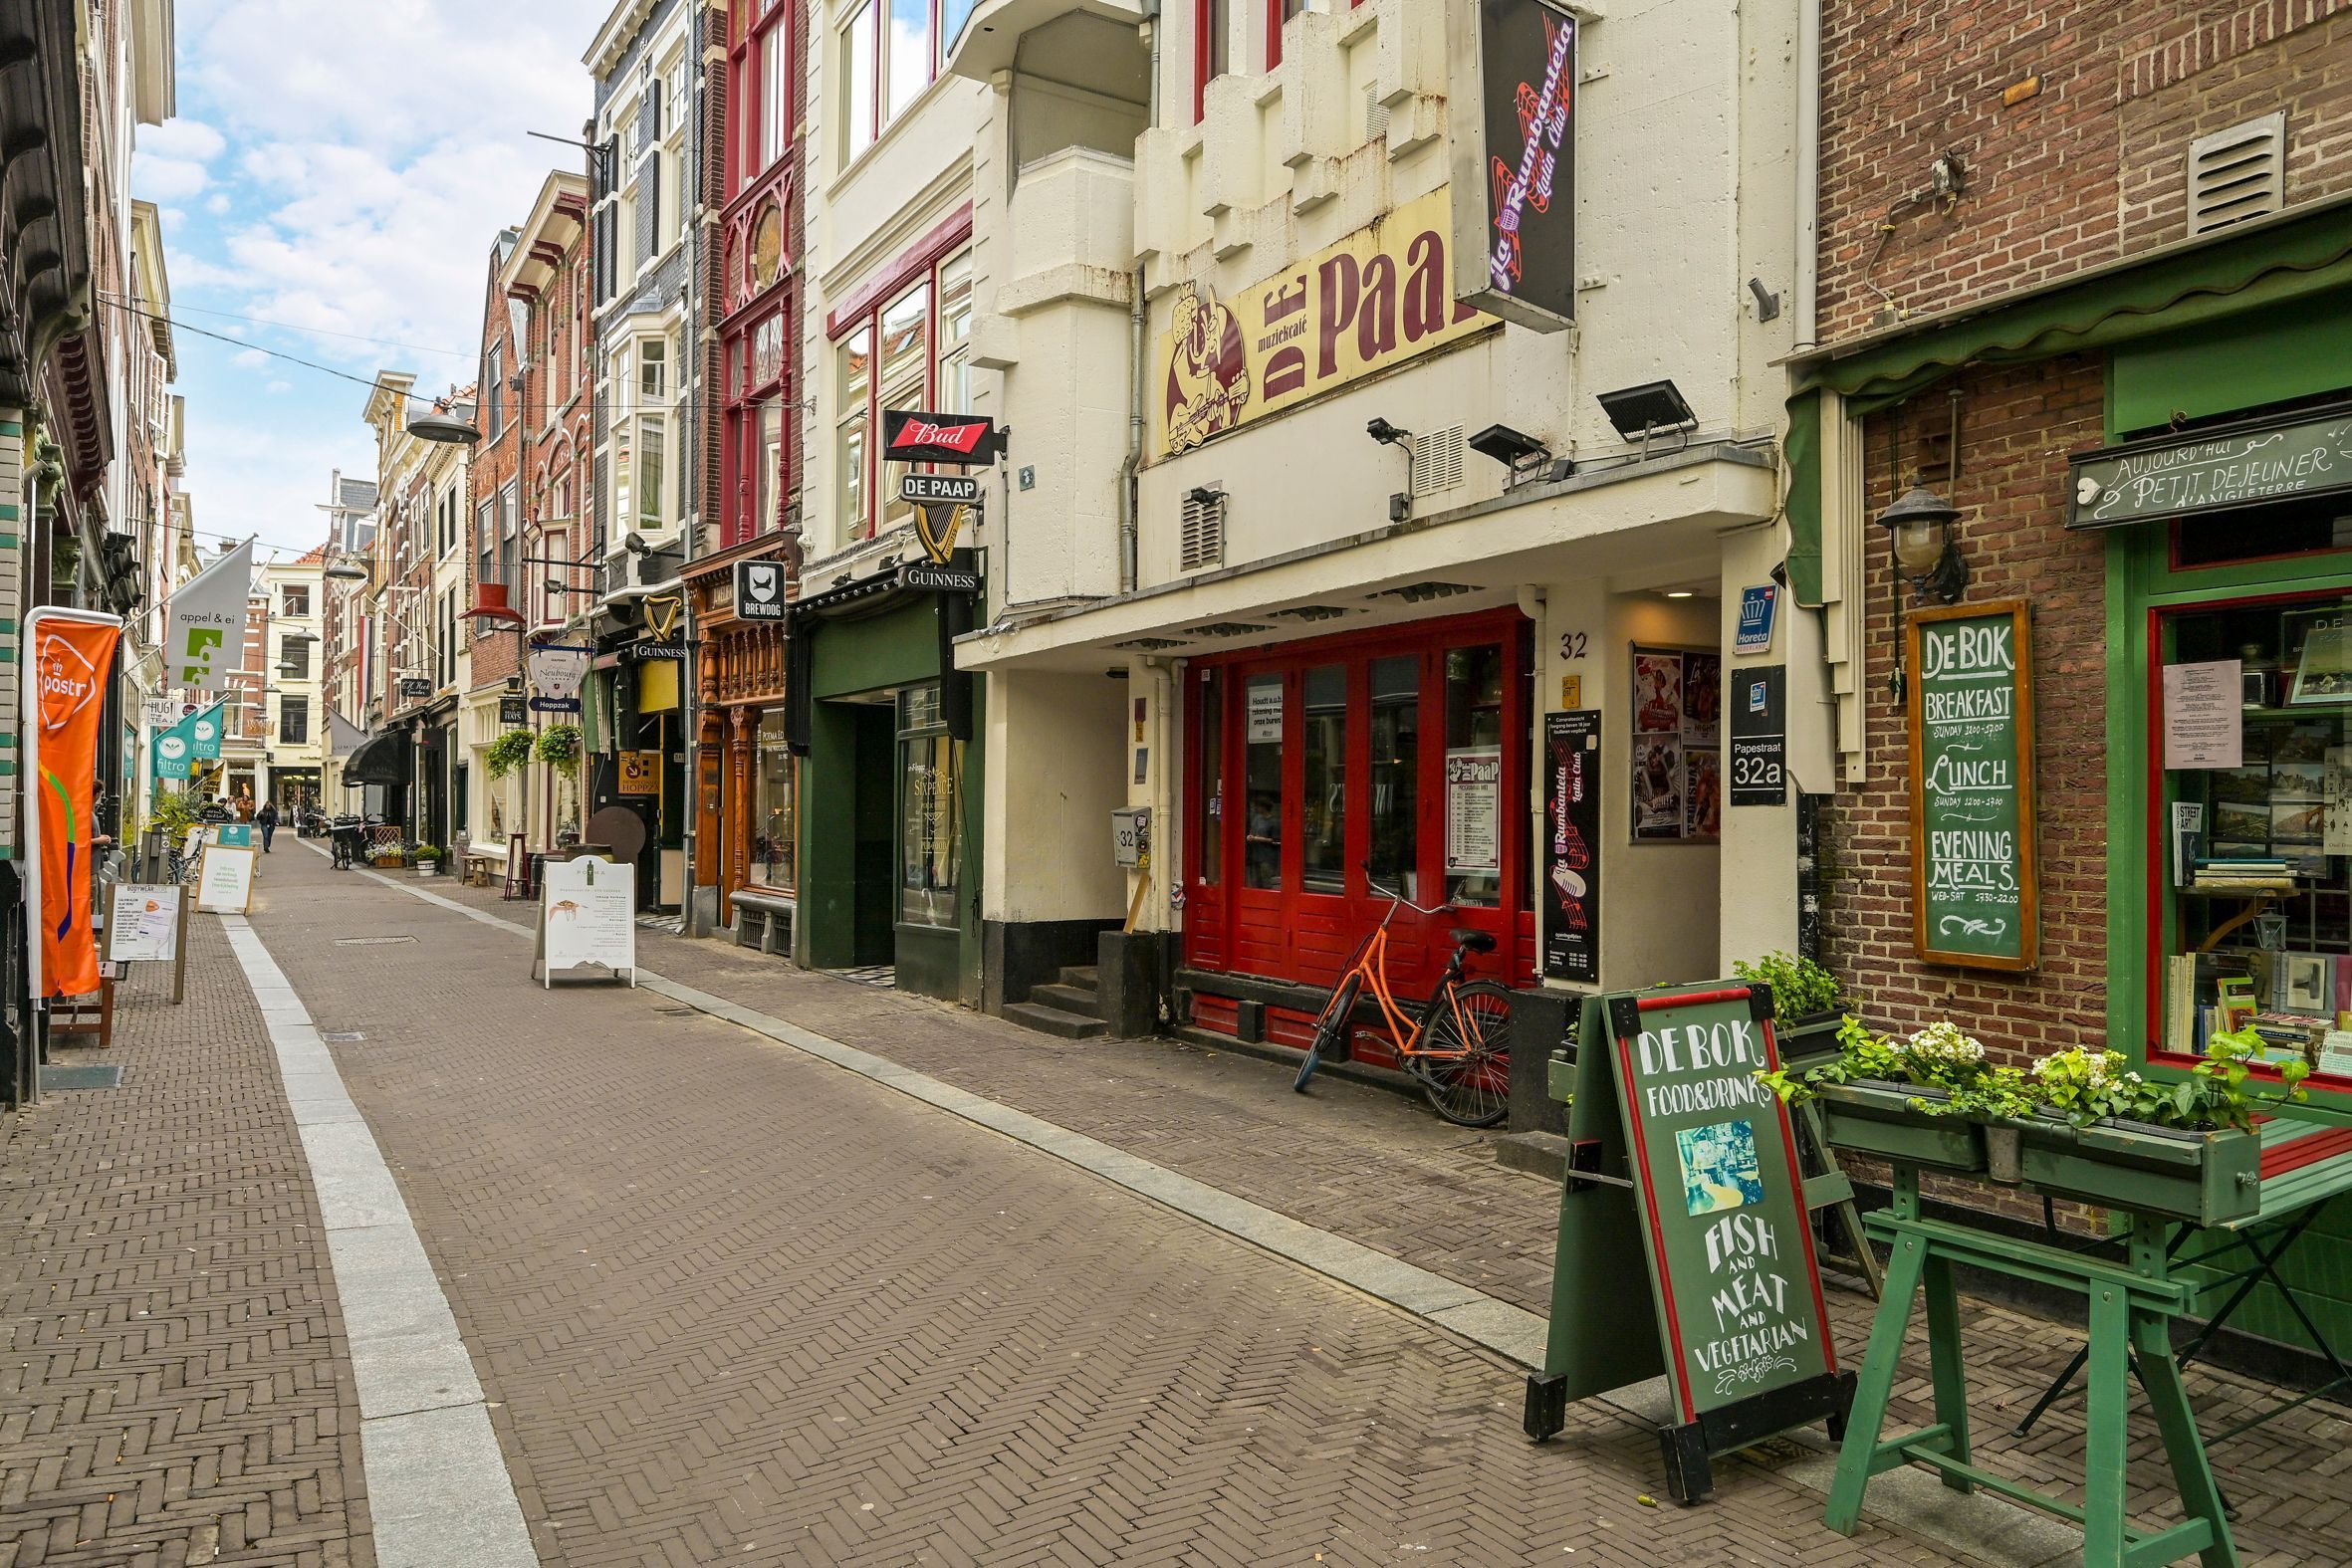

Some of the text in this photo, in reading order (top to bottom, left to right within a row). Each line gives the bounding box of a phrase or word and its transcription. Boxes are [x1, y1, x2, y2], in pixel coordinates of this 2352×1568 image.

[1508, 21, 1571, 211] Rumbantela
[1536, 106, 1565, 198] Latin Club
[1317, 230, 1478, 379] Paa
[1258, 316, 1307, 353] muziekcafé
[910, 423, 966, 445] Bud
[2108, 441, 2232, 487] AUJOURD'HUI
[905, 479, 975, 498] DE PAAP
[2133, 473, 2207, 509] PETIT
[908, 569, 975, 588] GUINNESS
[180, 612, 235, 625] appel & ei
[745, 602, 781, 616] BREWDOG
[1560, 632, 1587, 660] 32
[1738, 632, 1767, 644] Horeca
[638, 645, 685, 658] GUINNESS
[1923, 626, 2014, 679] DE BOK
[540, 701, 570, 710] Hoppzak
[1926, 687, 2013, 720] BREAKFAST
[1933, 725, 1963, 738] SUNDAY
[192, 740, 215, 752] iltro
[1735, 742, 1781, 756] Papestraat
[157, 759, 185, 773] filtro
[1735, 757, 1781, 785] 32a
[1925, 754, 2006, 795] LUNCH
[914, 777, 953, 796] SIXPENCE
[1555, 767, 1566, 844] Rumbantela
[1935, 796, 1962, 807] SUNDAY
[2180, 805, 2201, 819] STREET
[1120, 830, 1133, 846] 32
[1931, 830, 2012, 860] EVENING
[1928, 862, 2015, 891] MEALS
[1931, 891, 1966, 902] WED-SAT
[1637, 1019, 1766, 1076] DE BOK
[1646, 1074, 1772, 1117] FOOD&DRINKS
[1704, 1214, 1778, 1274] FISH
[1728, 1255, 1756, 1275] AND
[1711, 1272, 1788, 1334] MEAT
[1740, 1311, 1766, 1330] AND
[1694, 1316, 1808, 1372] VEGETARIAN
